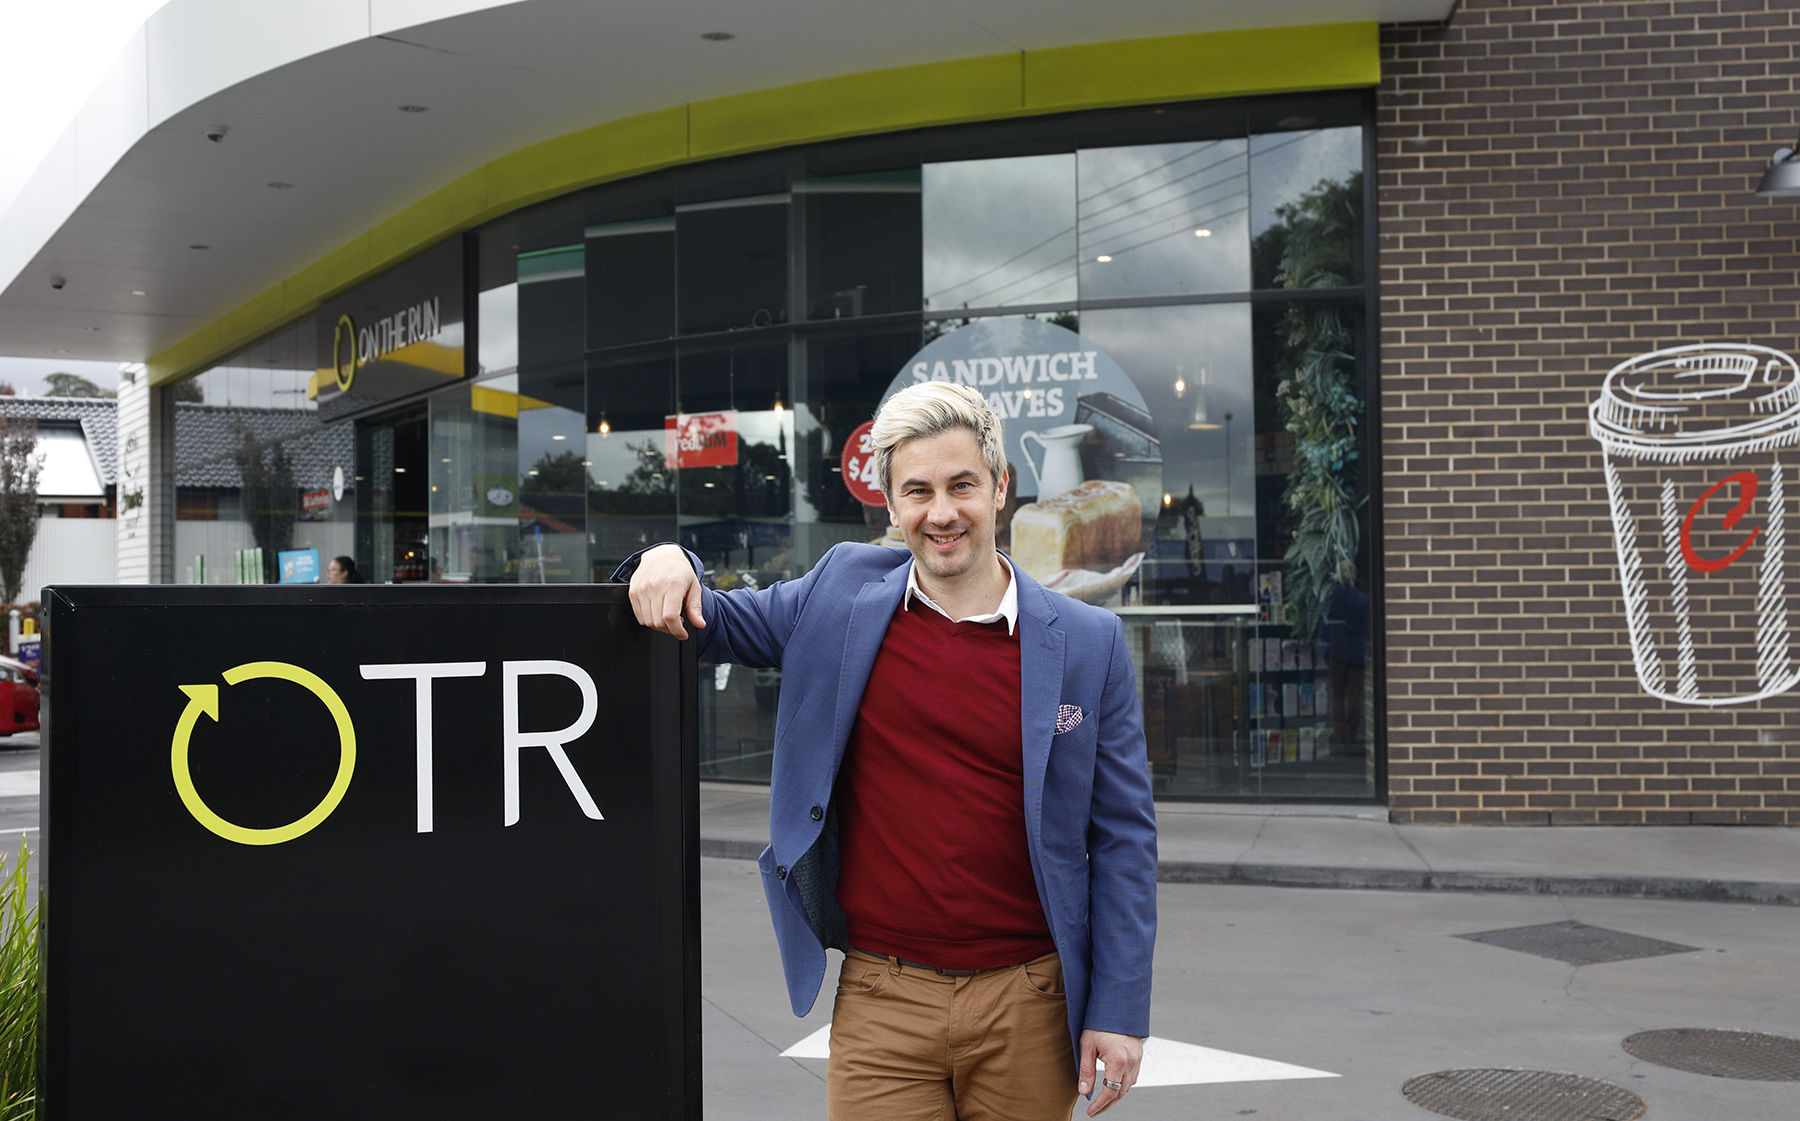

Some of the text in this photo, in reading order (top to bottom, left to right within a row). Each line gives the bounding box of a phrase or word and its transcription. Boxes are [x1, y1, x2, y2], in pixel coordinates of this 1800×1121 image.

[359, 296, 439, 362] ON THE RUN
[912, 351, 1097, 387] SANDWICH
[987, 387, 1064, 420] AVES
[171, 660, 604, 846] OTR
